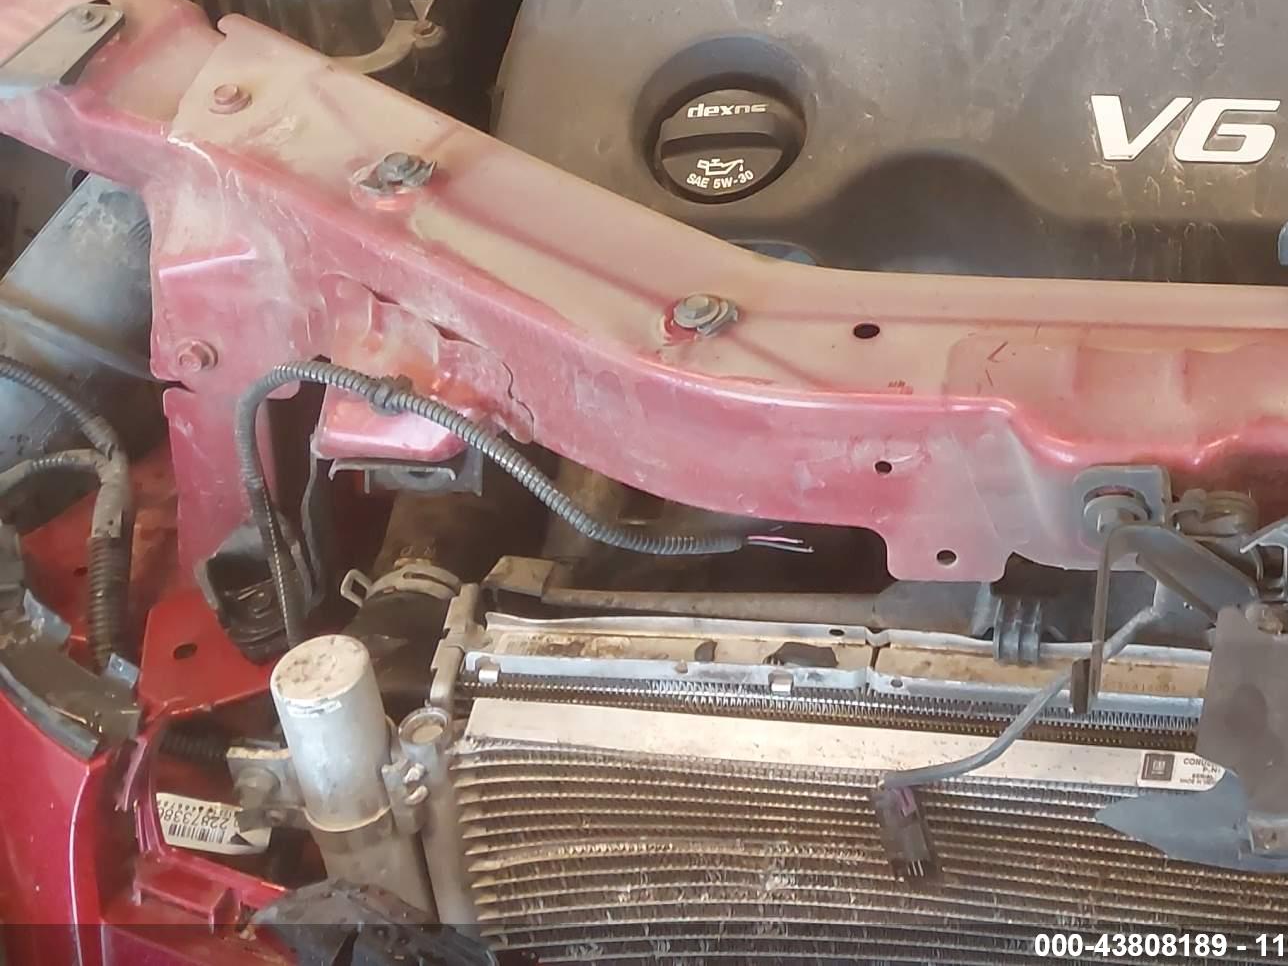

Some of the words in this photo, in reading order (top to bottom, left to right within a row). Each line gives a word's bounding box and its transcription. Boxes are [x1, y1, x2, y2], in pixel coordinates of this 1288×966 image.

[1090, 95, 1281, 163] V6
[686, 173, 710, 189] SAE
[713, 170, 754, 189] 5W-30
